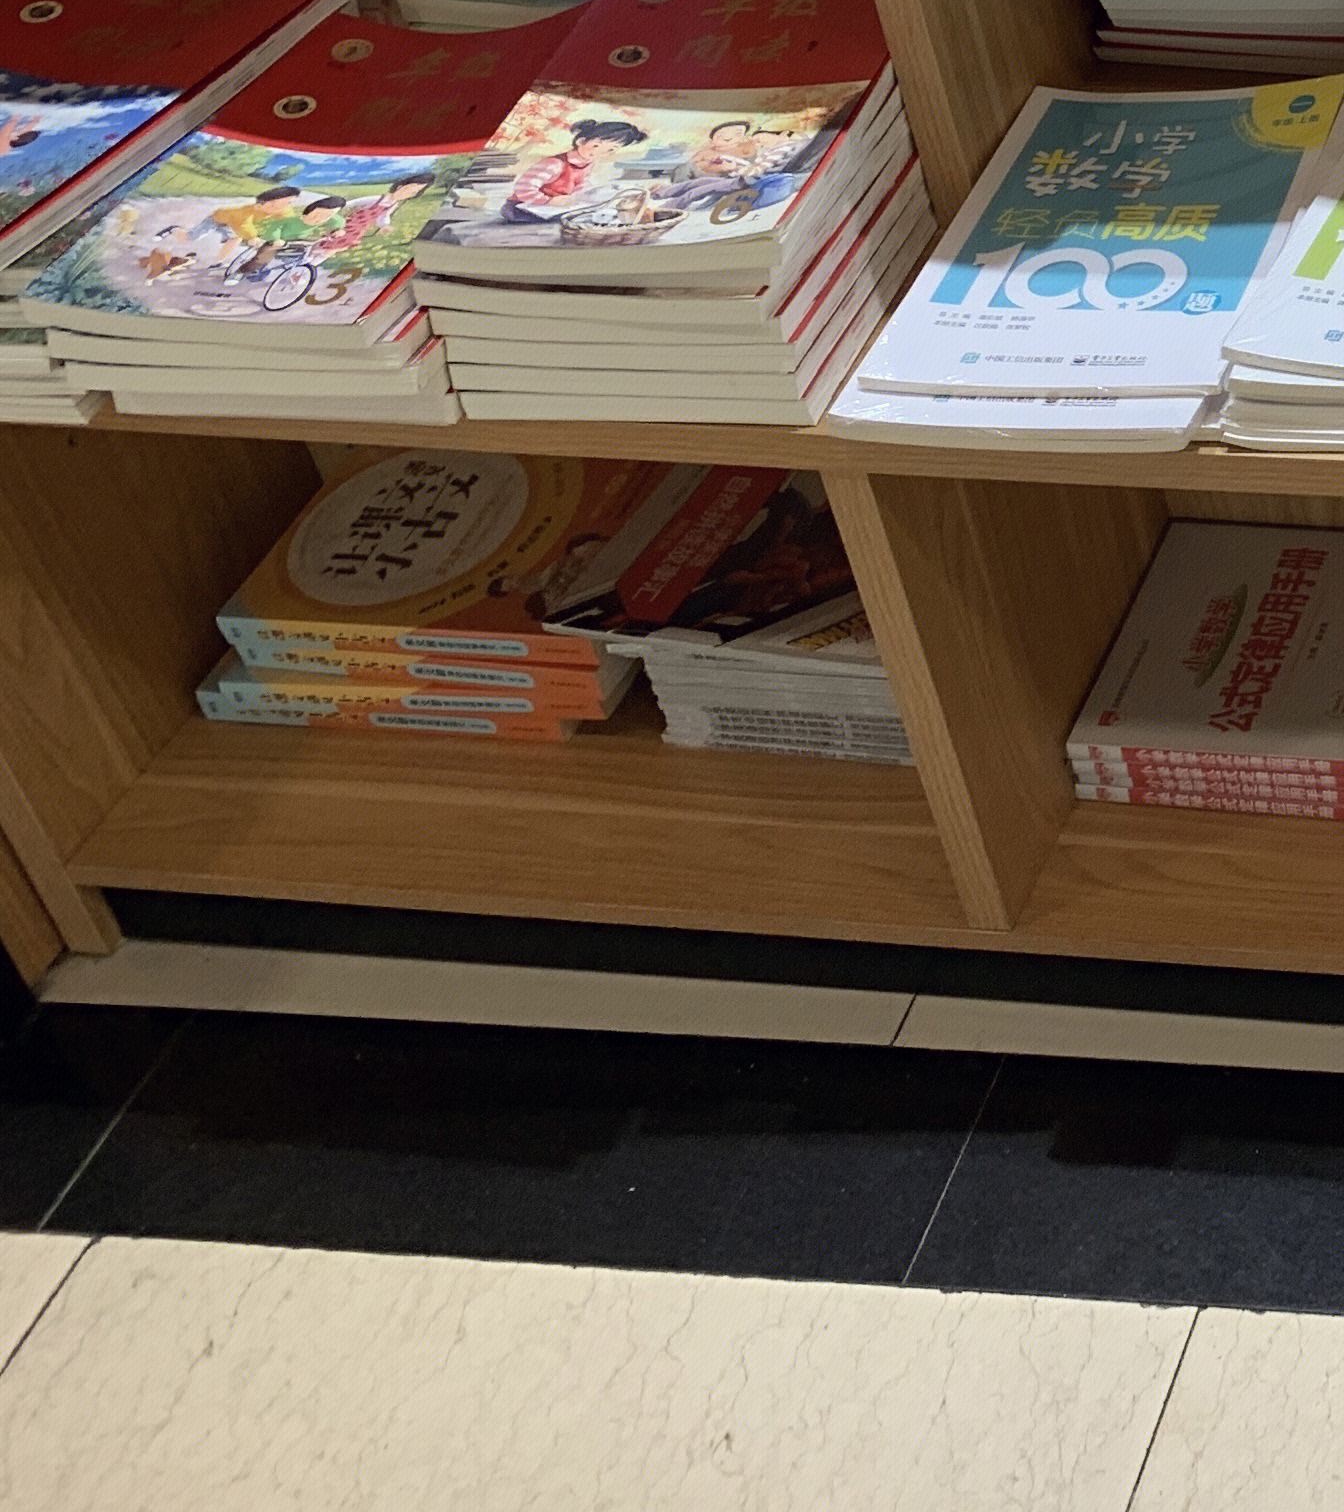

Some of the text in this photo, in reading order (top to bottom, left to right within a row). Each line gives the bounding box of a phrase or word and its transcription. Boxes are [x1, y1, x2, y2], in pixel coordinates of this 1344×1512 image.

[1084, 120, 1197, 155] 小学
[1025, 150, 1172, 200] 数学
[991, 202, 1221, 242] 轻负高质
[972, 241, 1220, 315] 100 题
